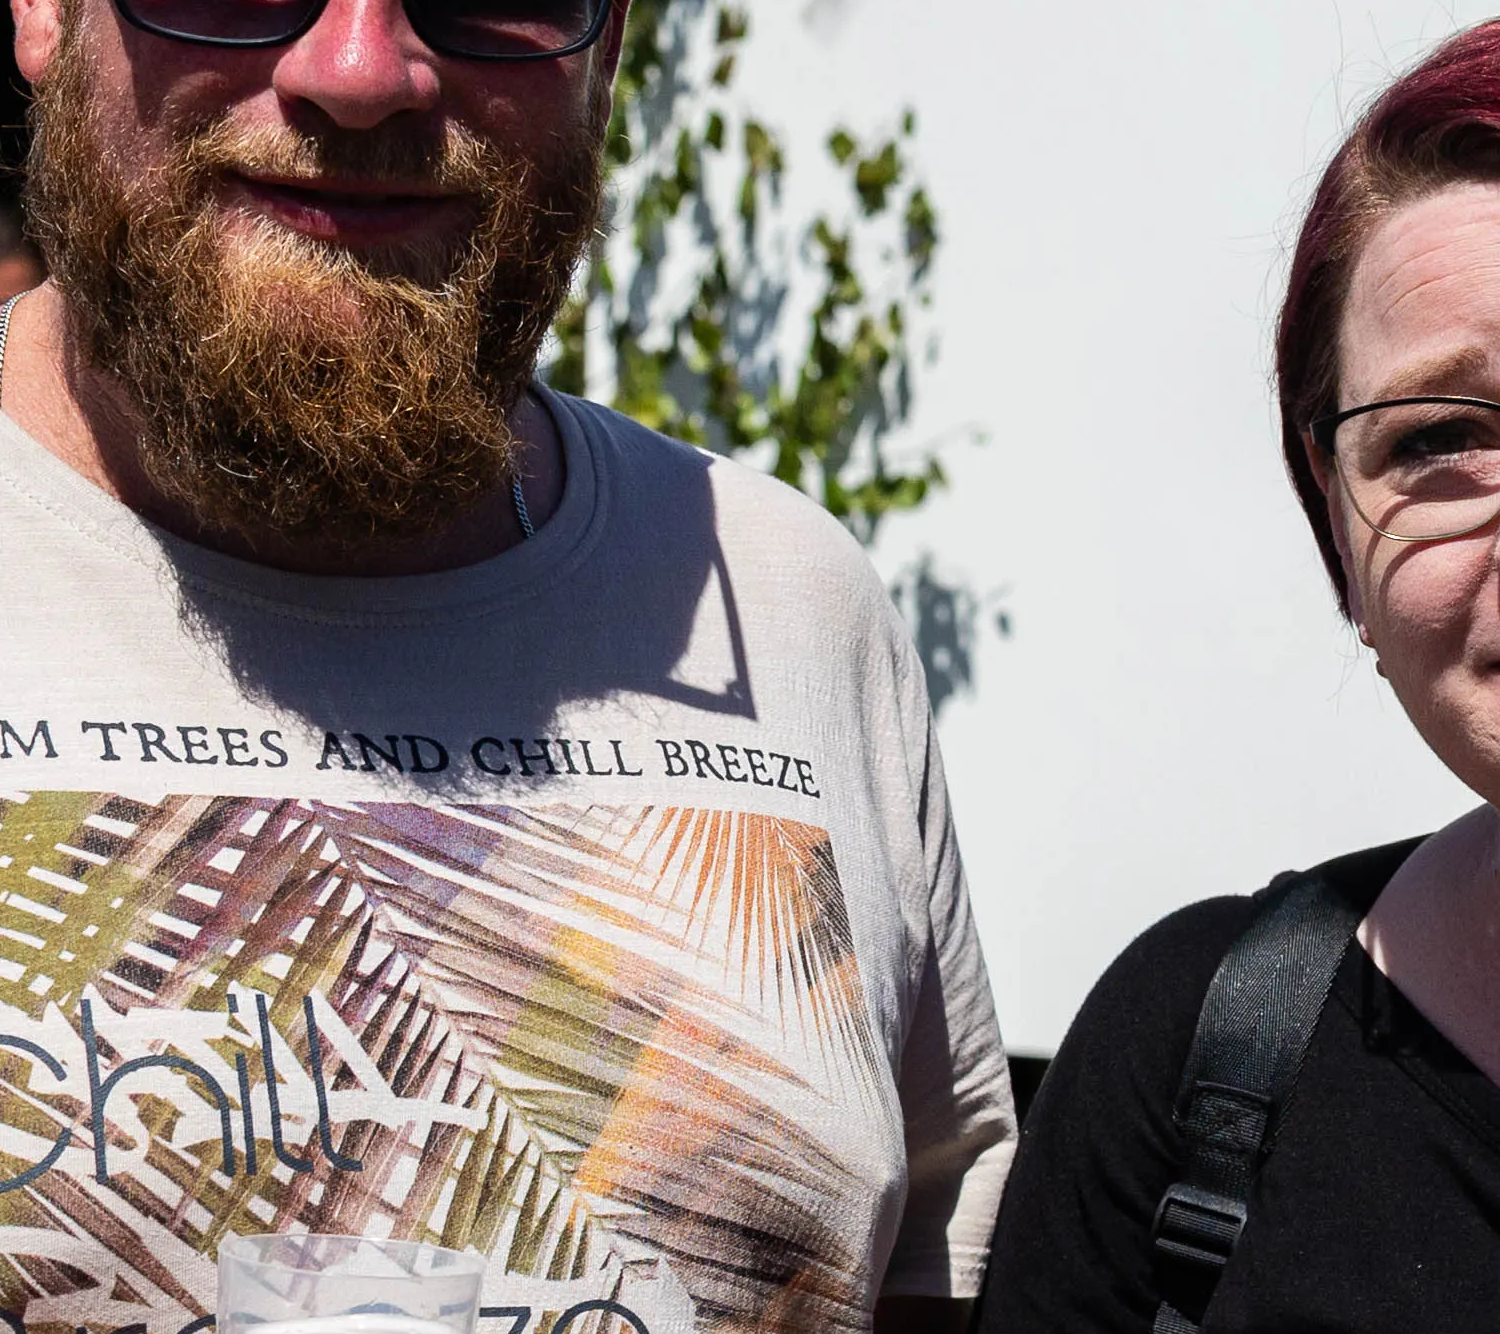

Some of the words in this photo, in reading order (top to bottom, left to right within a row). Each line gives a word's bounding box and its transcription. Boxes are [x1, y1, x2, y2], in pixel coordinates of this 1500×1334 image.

[81, 720, 289, 768] TREES
[315, 731, 450, 773] AND
[470, 736, 643, 777] CHILL
[655, 739, 821, 799] BREEZE
